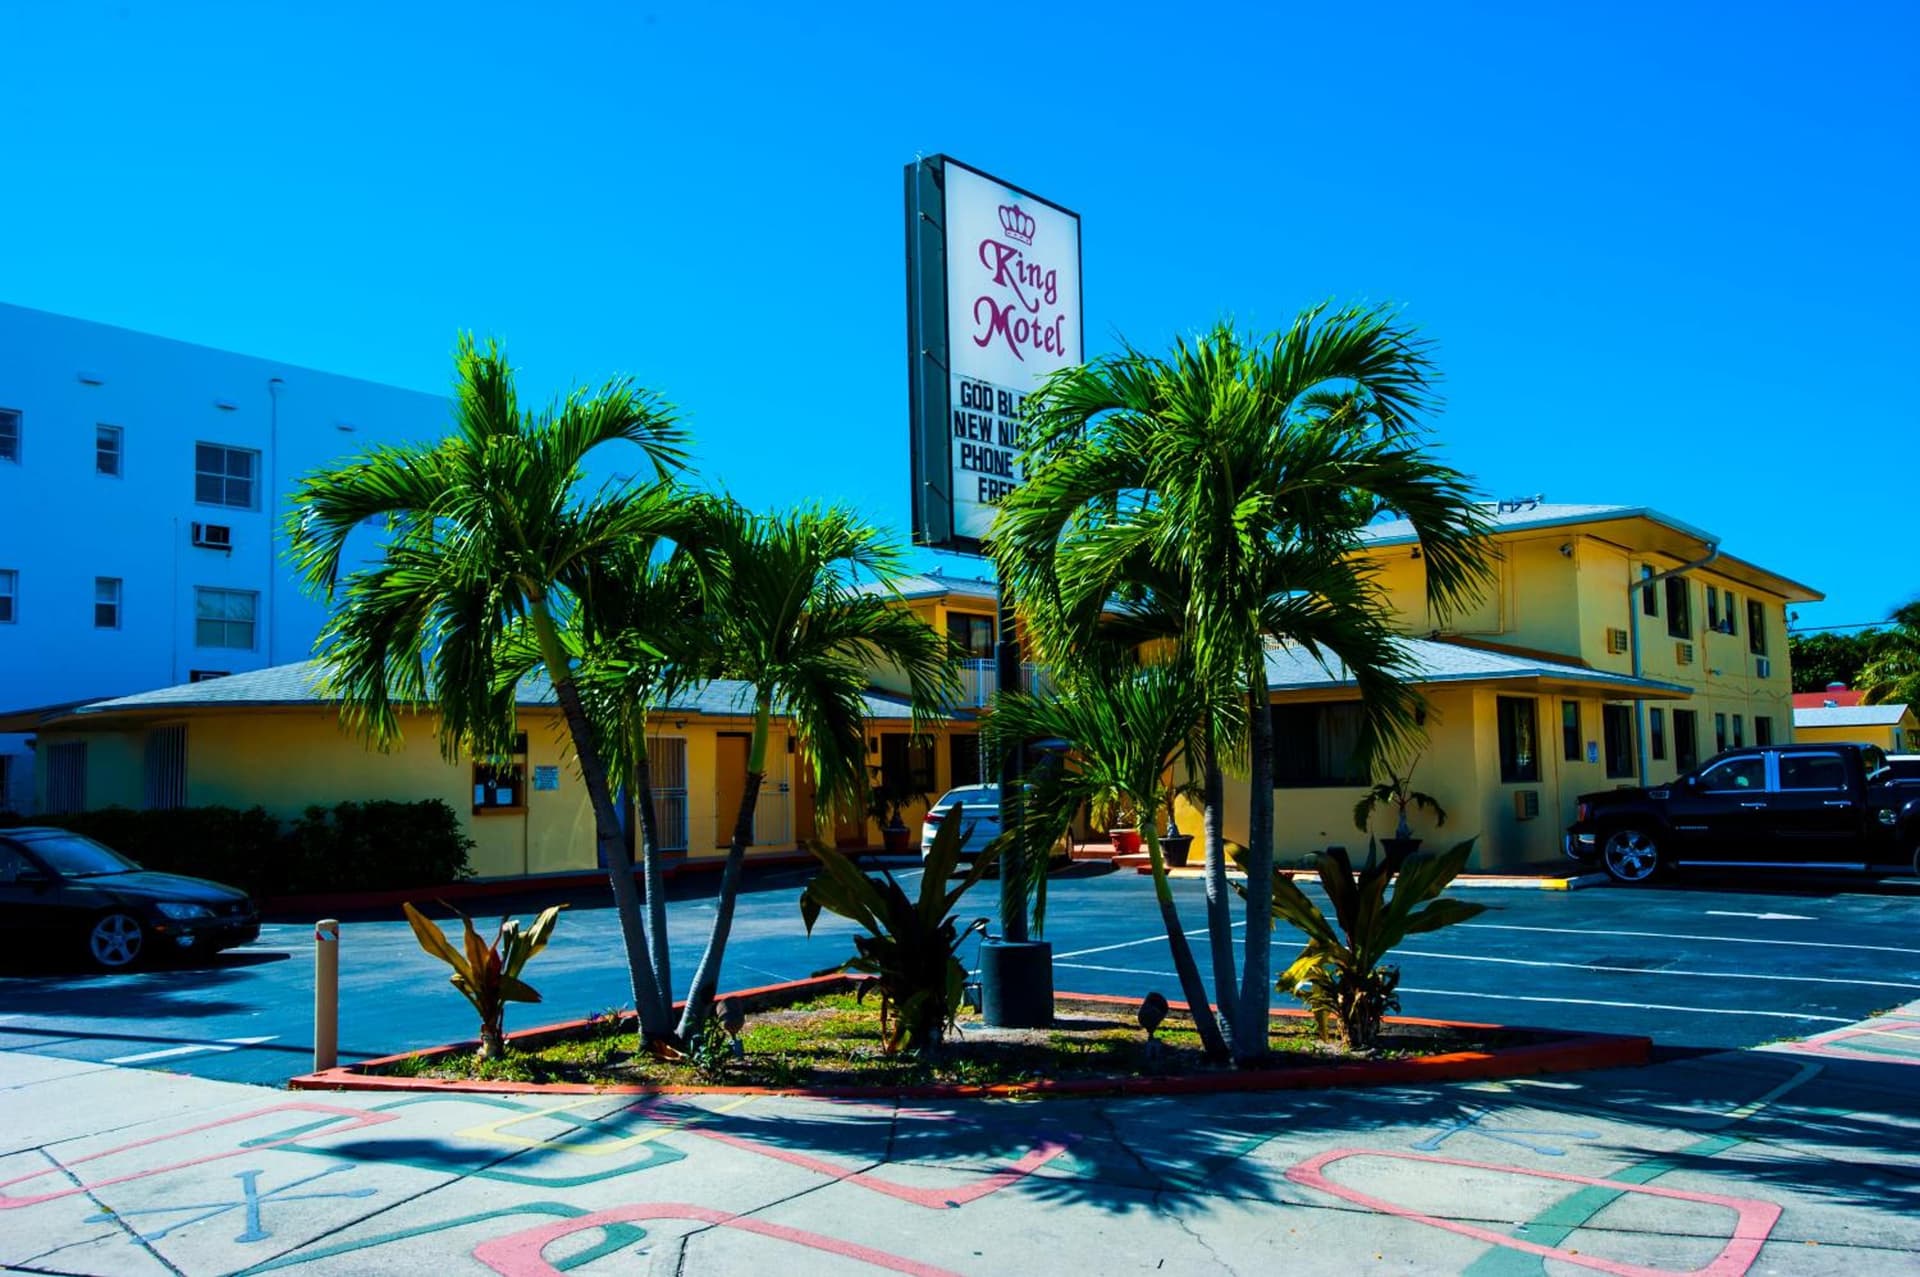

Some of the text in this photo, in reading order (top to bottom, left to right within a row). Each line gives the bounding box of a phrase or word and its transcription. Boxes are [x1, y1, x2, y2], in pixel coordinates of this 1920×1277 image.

[978, 238, 1058, 314] King
[972, 295, 1066, 363] Motel
[960, 380, 1046, 424] GOD BLE
[953, 410, 994, 444] NEW
[997, 420, 1032, 453] NIC
[960, 442, 1014, 479] PHONE
